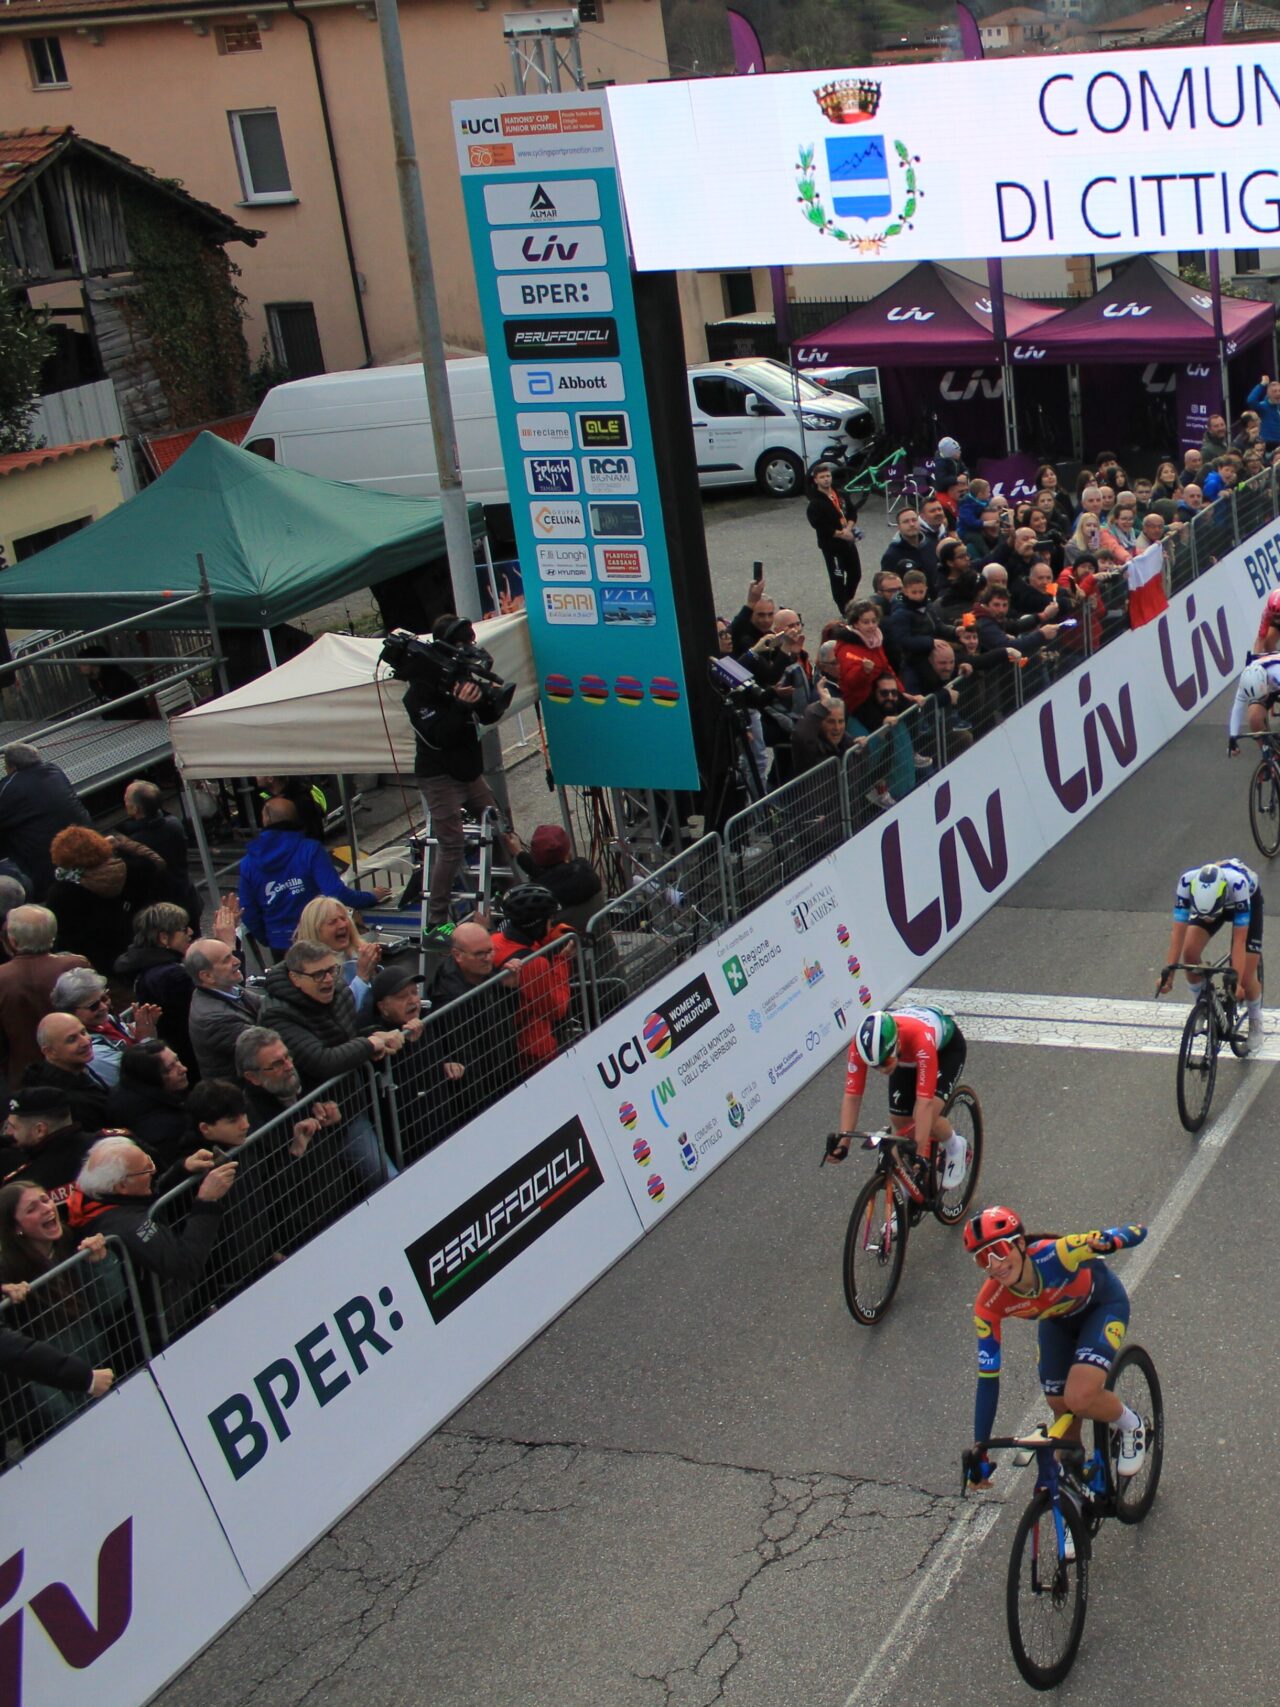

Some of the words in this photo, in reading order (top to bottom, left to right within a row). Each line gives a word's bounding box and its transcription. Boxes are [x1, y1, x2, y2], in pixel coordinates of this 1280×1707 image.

[467, 118, 499, 135] UCI
[504, 115, 535, 125] NATIONS'
[536, 114, 550, 122] CUP
[505, 124, 530, 134] JUNIOR
[530, 123, 558, 132] WOMEN
[530, 209, 557, 219] ALMAR
[995, 179, 1053, 244] DI
[522, 235, 579, 262] Liv
[521, 282, 590, 305] BPER:
[887, 307, 936, 321] Liv
[1103, 302, 1152, 318] Liv
[514, 329, 610, 344] PERUFFOCICLI
[797, 348, 829, 362] Liv
[1013, 346, 1046, 359] Liv
[558, 375, 608, 390] Abbott
[939, 370, 1004, 401] Liv
[532, 428, 569, 437] reclame
[533, 459, 570, 477] Splash
[588, 458, 629, 474] RCA
[590, 474, 630, 482] BIGNAMI
[993, 479, 1038, 499] Liv
[543, 515, 581, 525] CELLINA
[556, 549, 587, 562] Longhi
[1159, 594, 1234, 711] Liv
[1039, 672, 1138, 814] Liv
[881, 780, 1008, 956] Liv
[741, 939, 770, 966] Regione
[745, 944, 782, 978] Lombardia
[668, 991, 701, 1022] WOMEN'S
[673, 998, 713, 1033] WORLDTOUR
[597, 1035, 647, 1090] UCI
[428, 1137, 585, 1287] PERUFFOCICLI
[207, 1286, 404, 1482] BPER:
[0, 1514, 133, 1707] iv
